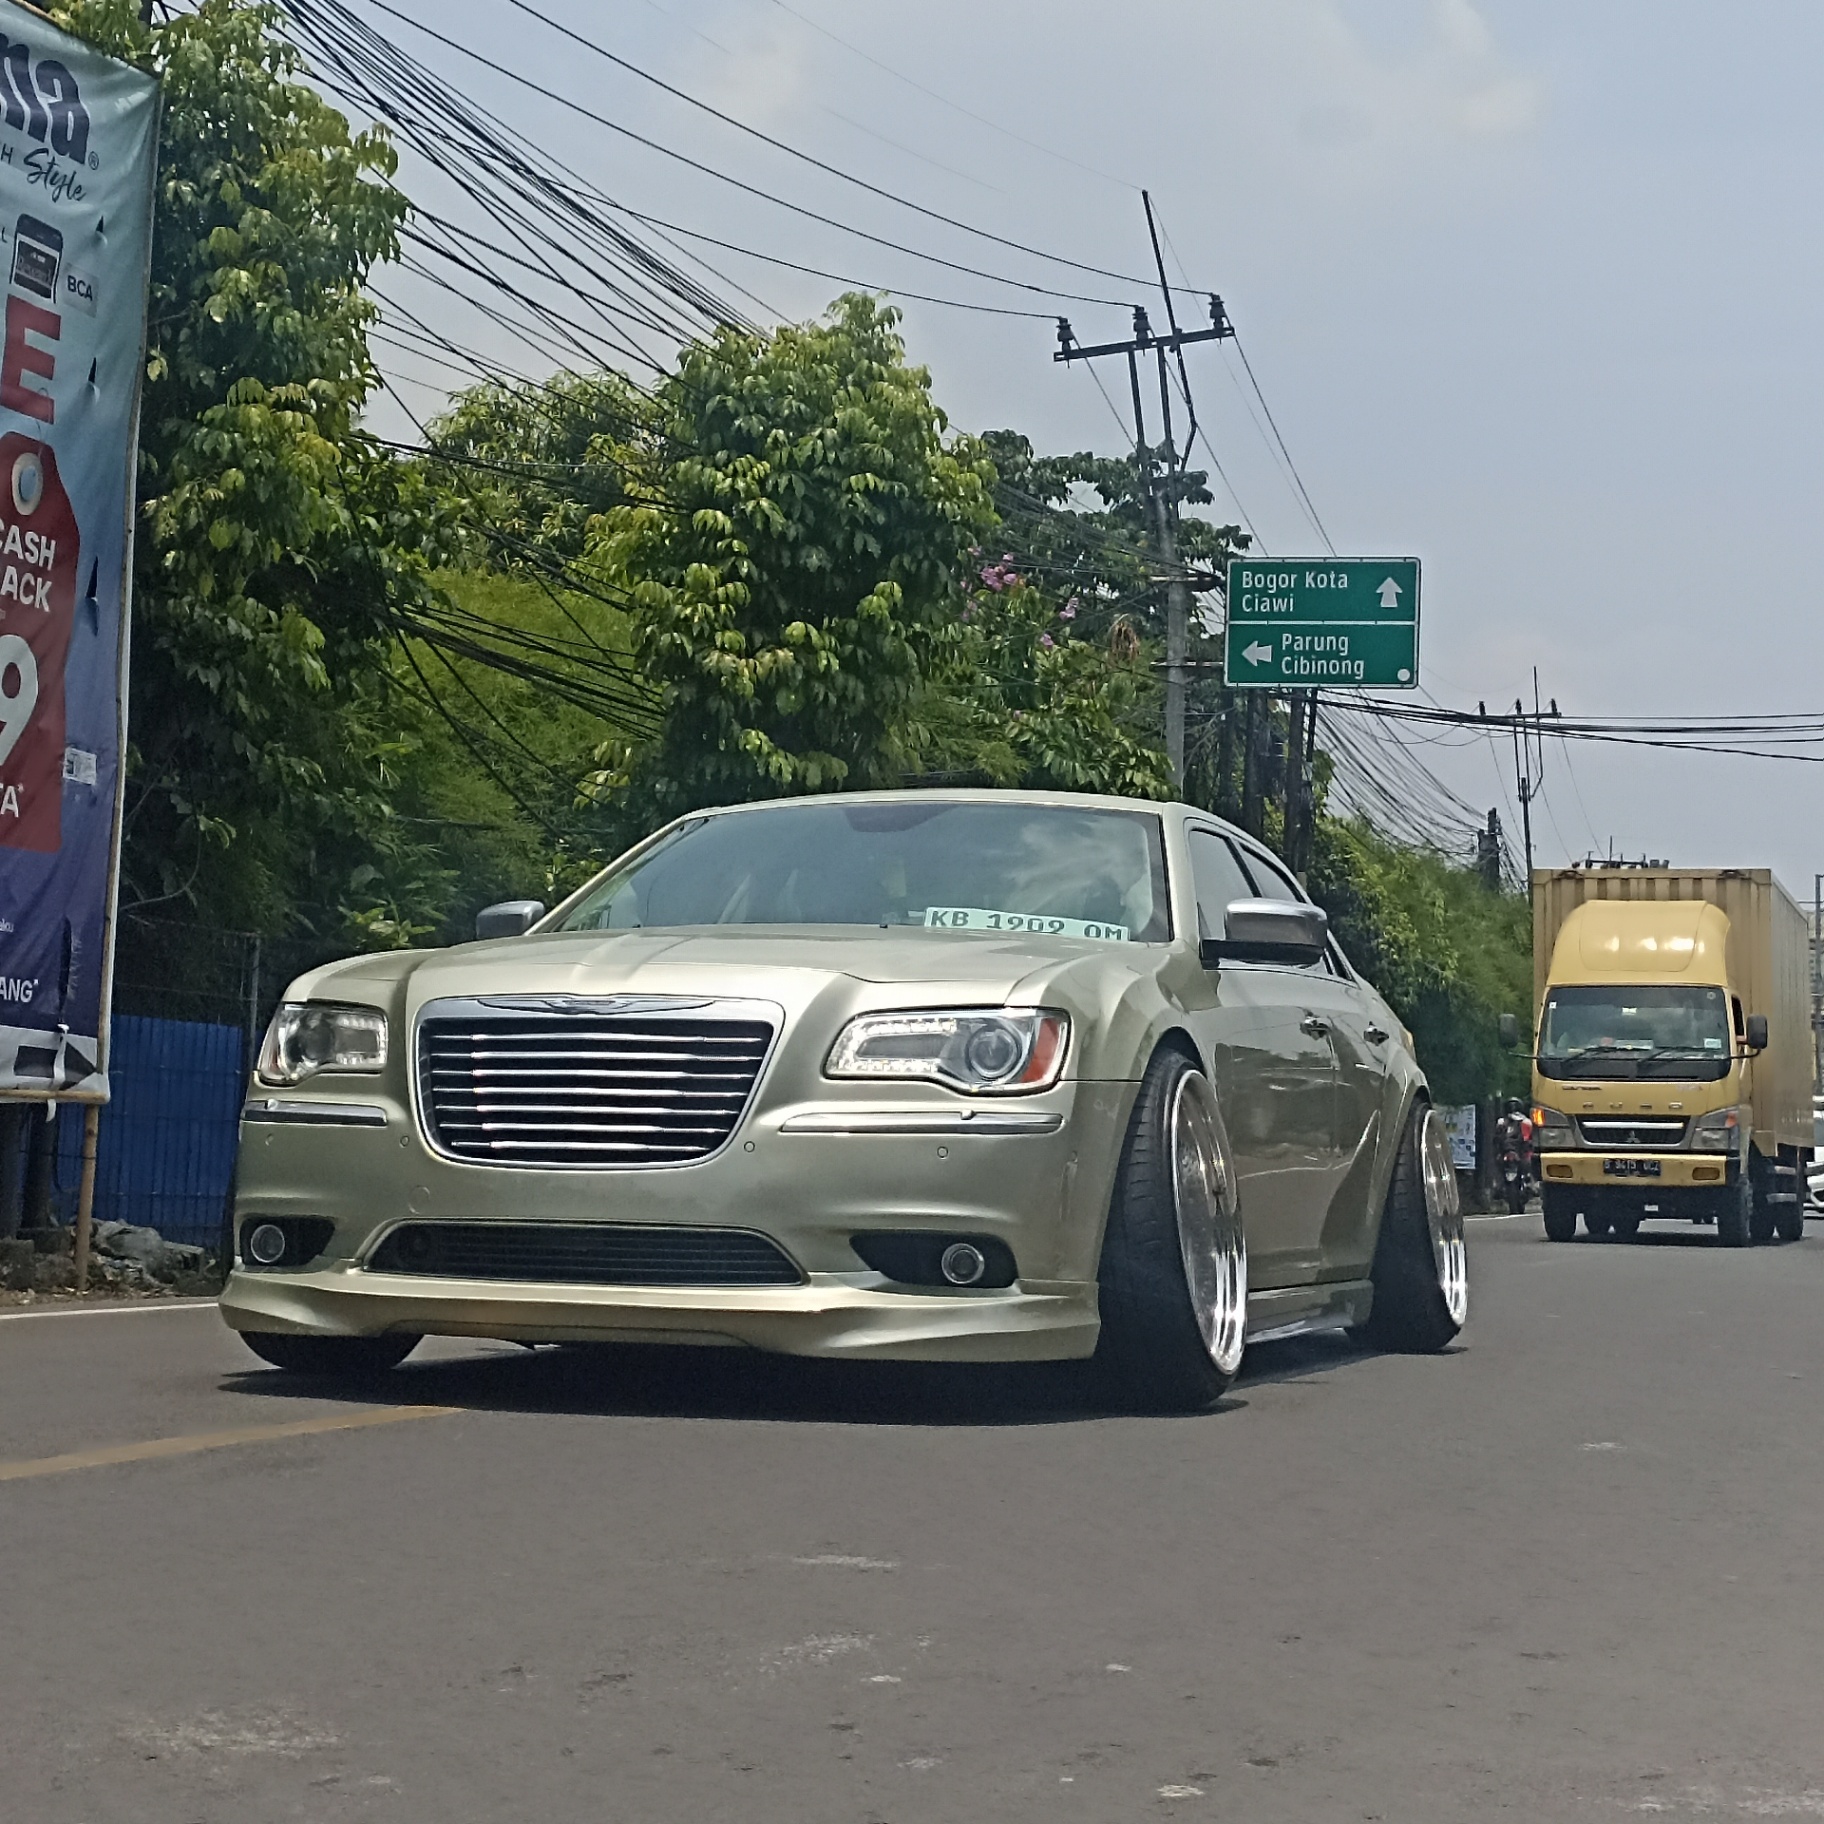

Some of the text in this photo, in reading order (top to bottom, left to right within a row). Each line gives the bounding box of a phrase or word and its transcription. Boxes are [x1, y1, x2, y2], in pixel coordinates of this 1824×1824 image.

[23, 147, 87, 203] Style
[67, 274, 93, 302] BCA
[0, 293, 61, 425] E
[0, 517, 56, 572] ASH
[0, 565, 52, 613] ACK
[1242, 571, 1348, 593] Bogor Kota
[1242, 594, 1294, 612] Ciawi
[1282, 633, 1349, 655] Parung
[1281, 656, 1365, 679] Cibinong
[0, 634, 39, 767] 9
[931, 910, 969, 928] KB
[1084, 924, 1122, 941] OM
